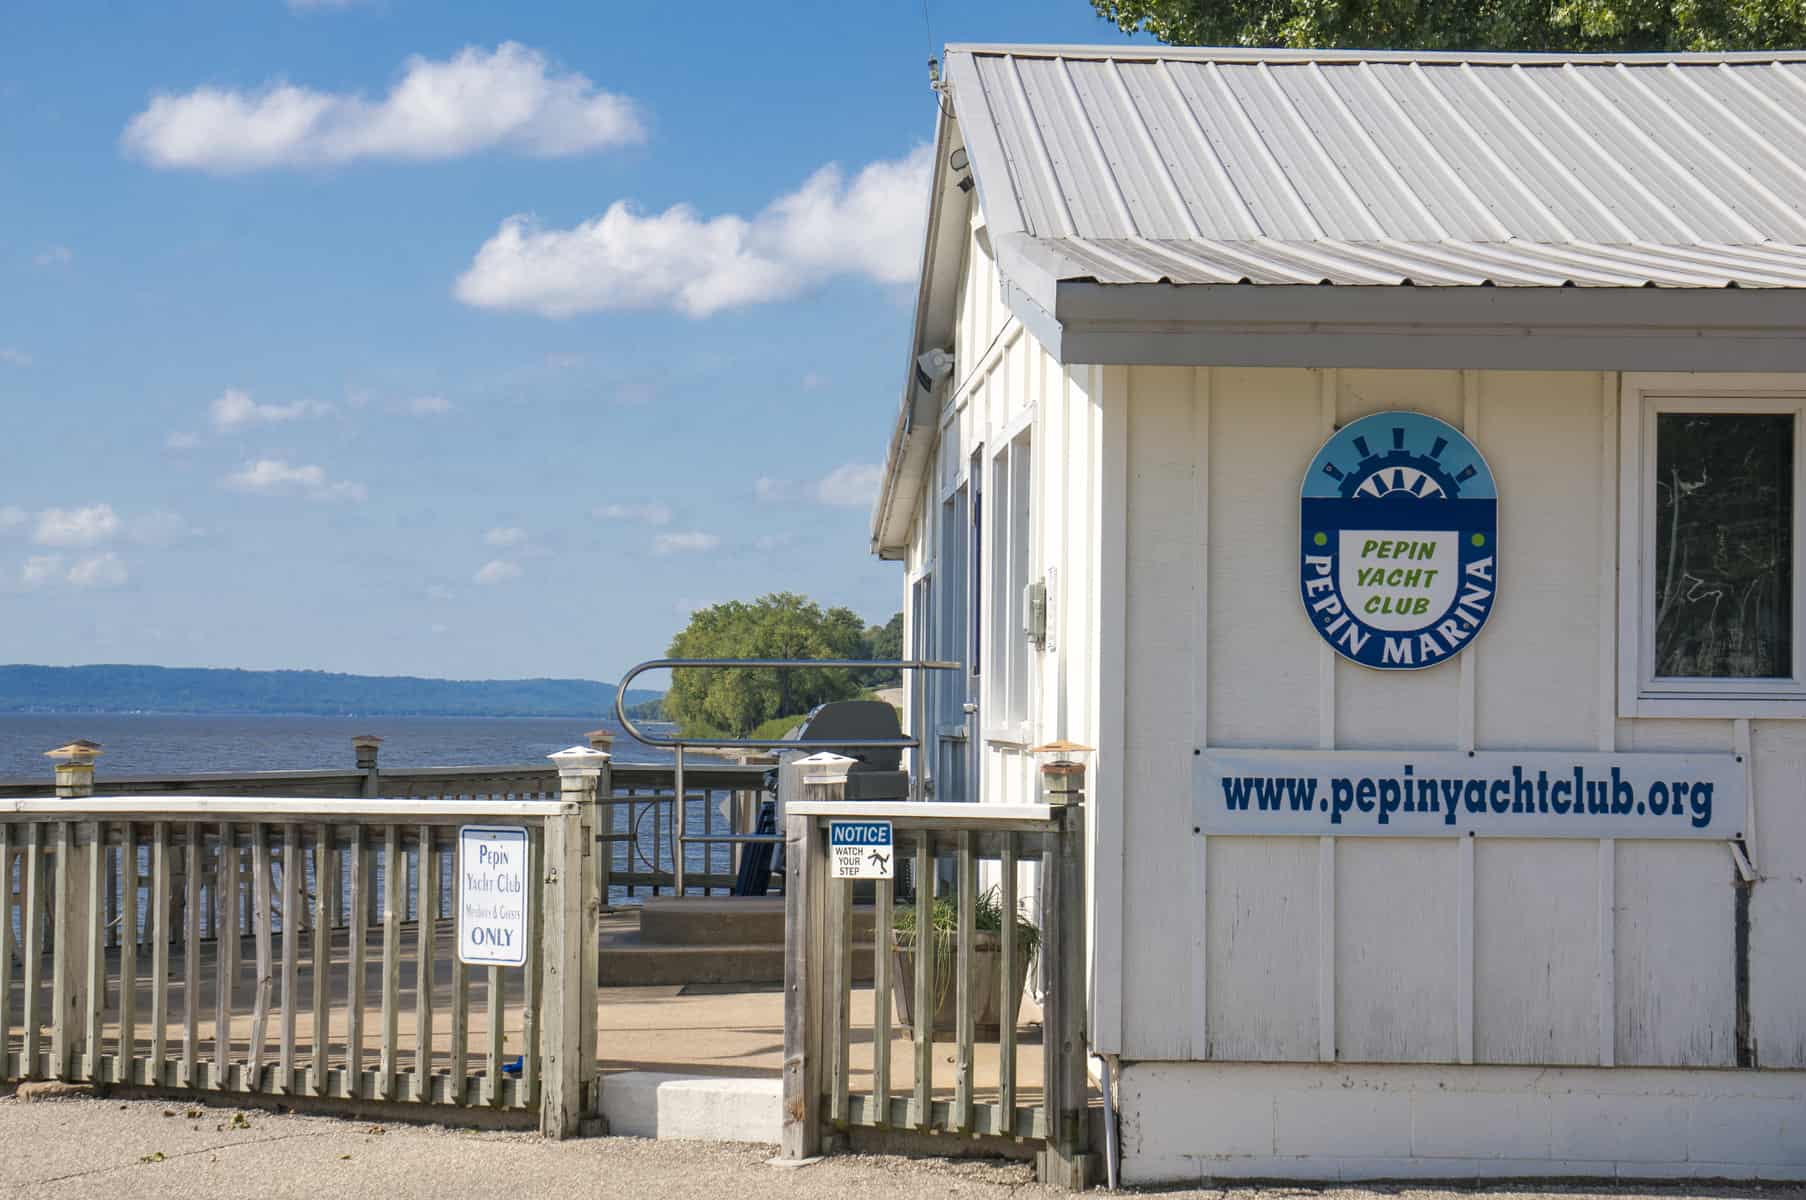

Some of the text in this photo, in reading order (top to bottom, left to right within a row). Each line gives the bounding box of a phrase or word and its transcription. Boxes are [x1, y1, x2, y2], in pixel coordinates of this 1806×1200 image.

[1361, 540, 1436, 560] PEPIN
[1357, 568, 1438, 588] YACHT
[1305, 554, 1493, 665] PEPIN MARINA
[1364, 596, 1430, 615] CLUB
[1222, 765, 1714, 828] www.pepinyachtclub.org
[834, 827, 888, 842] NOTICE
[835, 847, 863, 855] WATCH
[839, 857, 860, 865] YOUR
[840, 867, 860, 876] STEP
[497, 873, 520, 893] Club
[471, 927, 514, 946] ONLY
